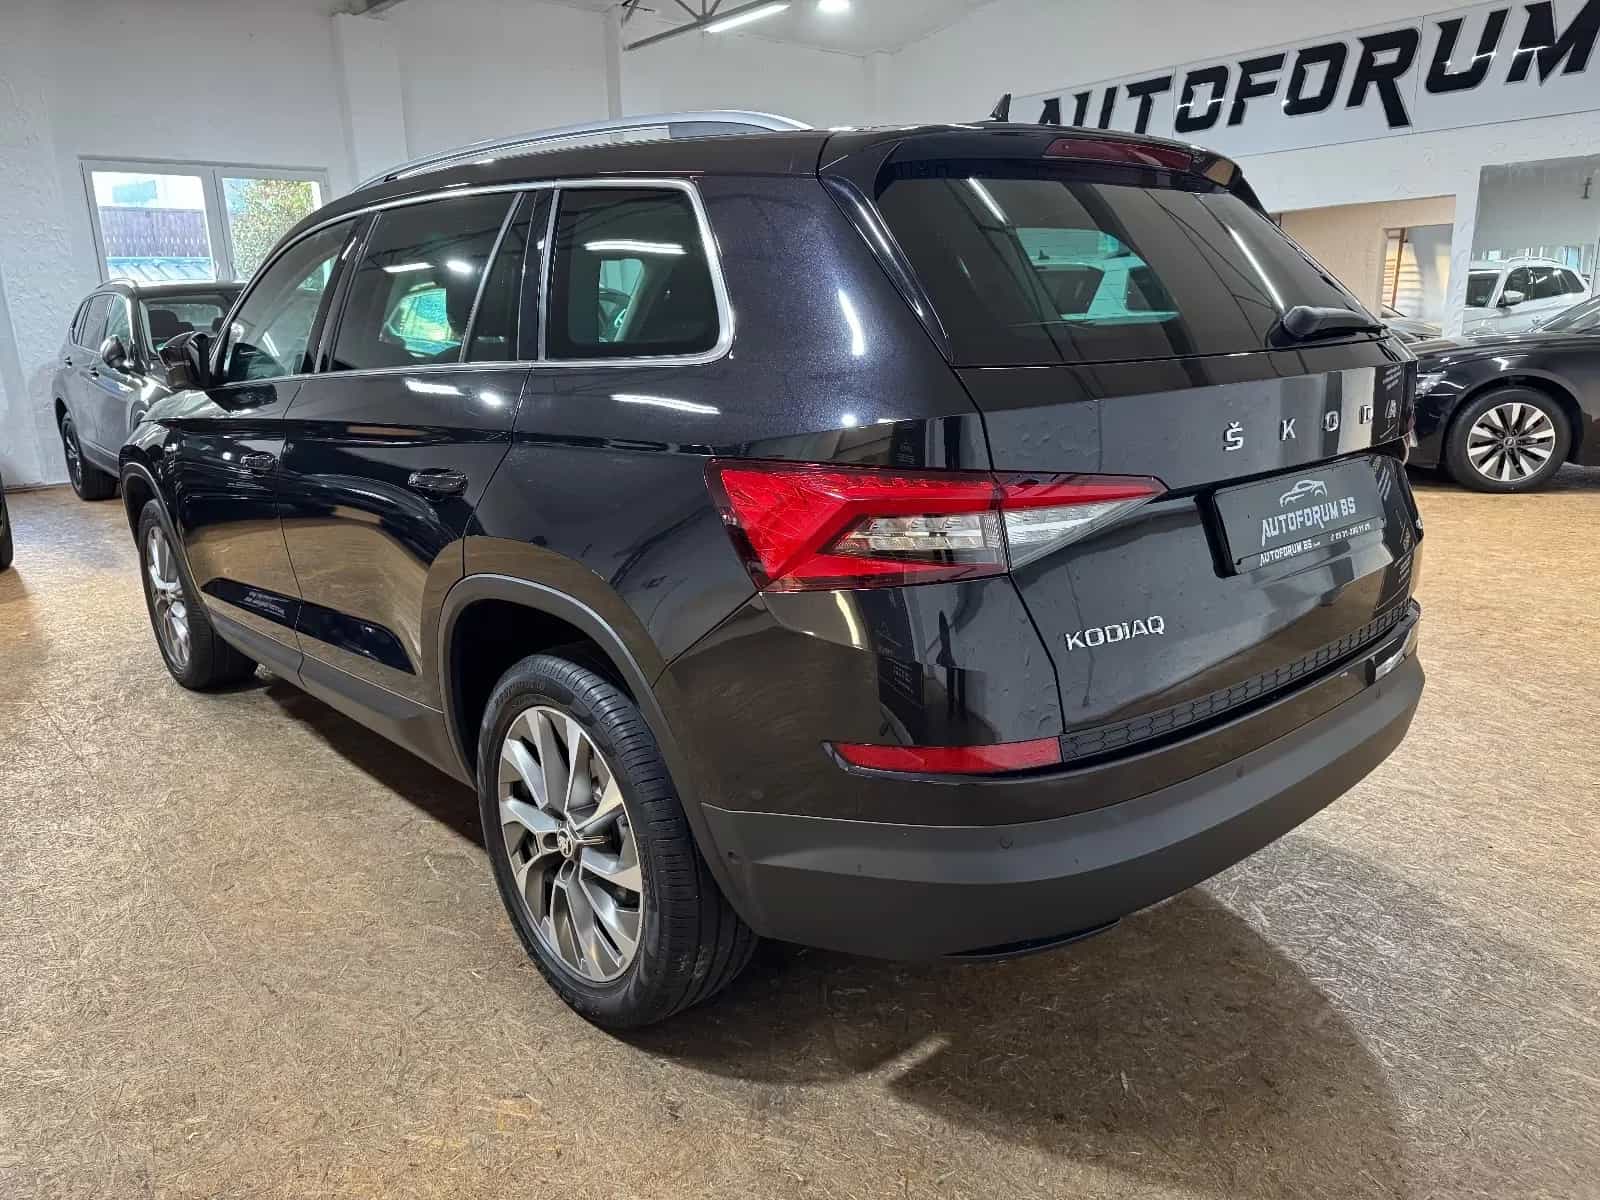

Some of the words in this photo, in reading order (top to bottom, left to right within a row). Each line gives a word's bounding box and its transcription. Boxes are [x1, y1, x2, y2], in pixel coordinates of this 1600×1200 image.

[1261, 501, 1339, 547] AUTOFORUM
[1339, 497, 1356, 518] BS
[1260, 541, 1302, 567] AUTOFORUM
[1065, 615, 1165, 651] KODIAQ
